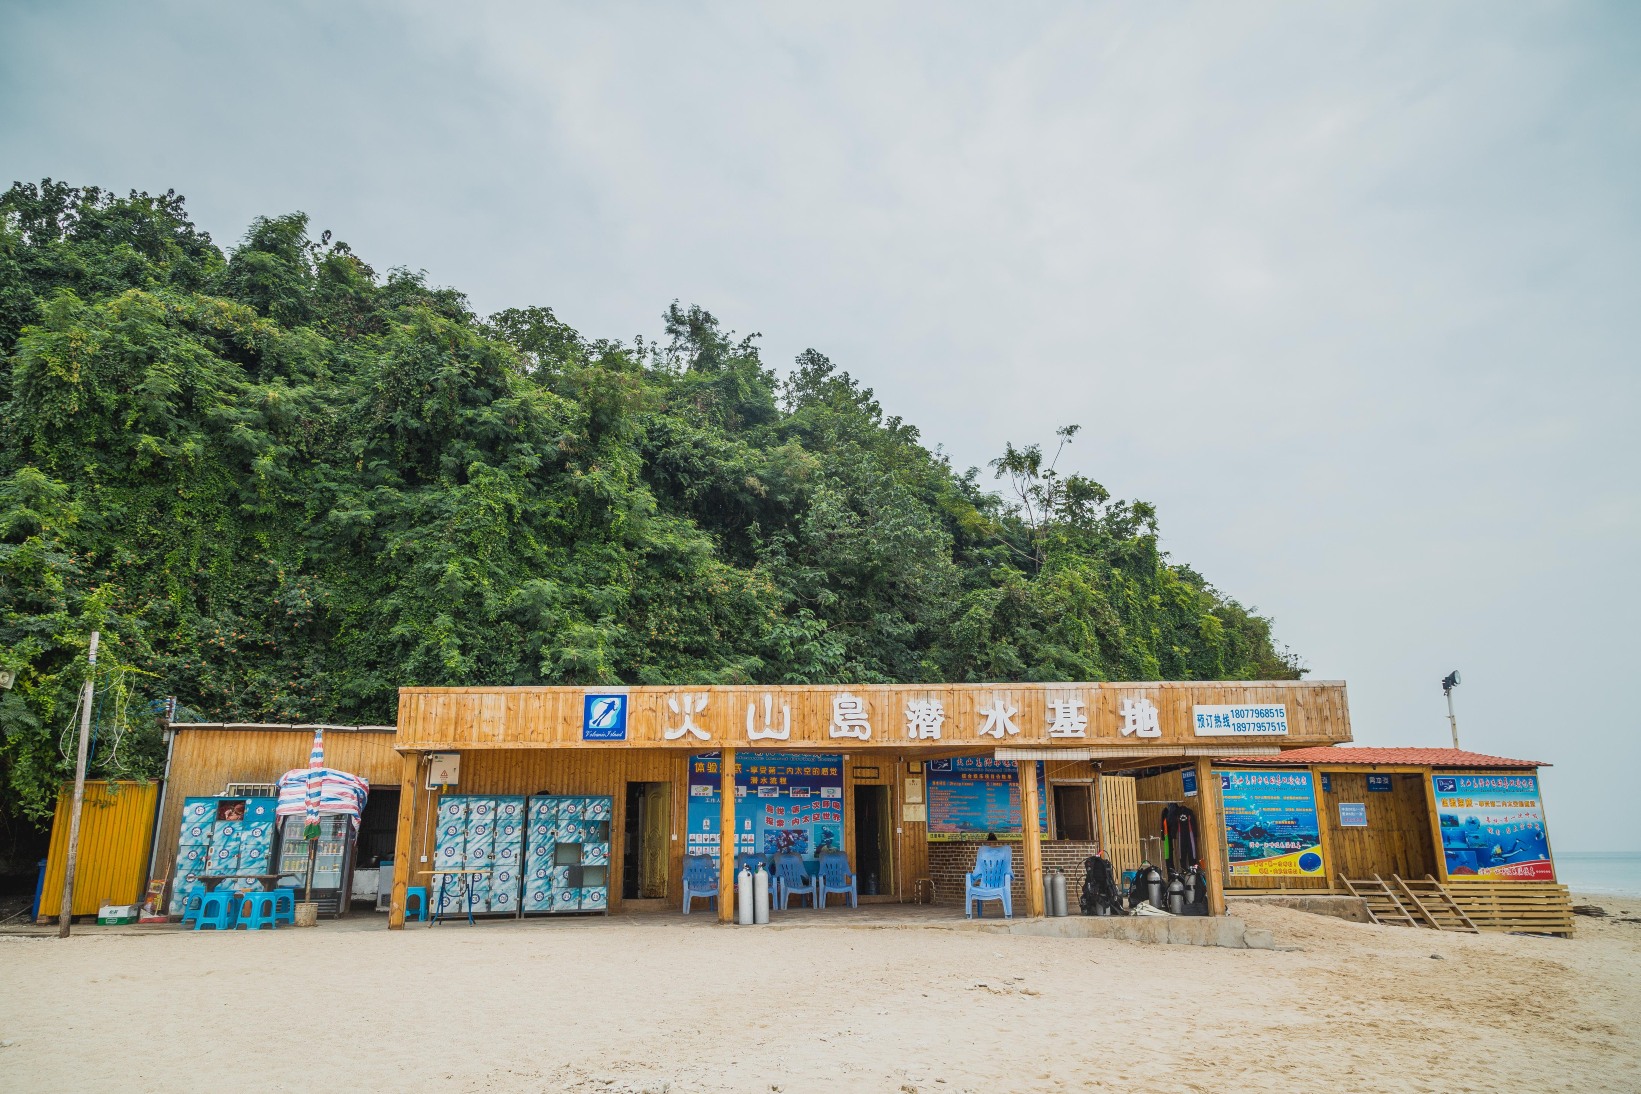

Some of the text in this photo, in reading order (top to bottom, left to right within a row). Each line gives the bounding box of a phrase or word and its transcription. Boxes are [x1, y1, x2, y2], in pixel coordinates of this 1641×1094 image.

[664, 693, 1162, 740] 火山島潜水基地
[1230, 708, 1285, 719] 18077968515
[1197, 713, 1231, 729] 预订热线
[1232, 721, 1287, 732] 18977957515
